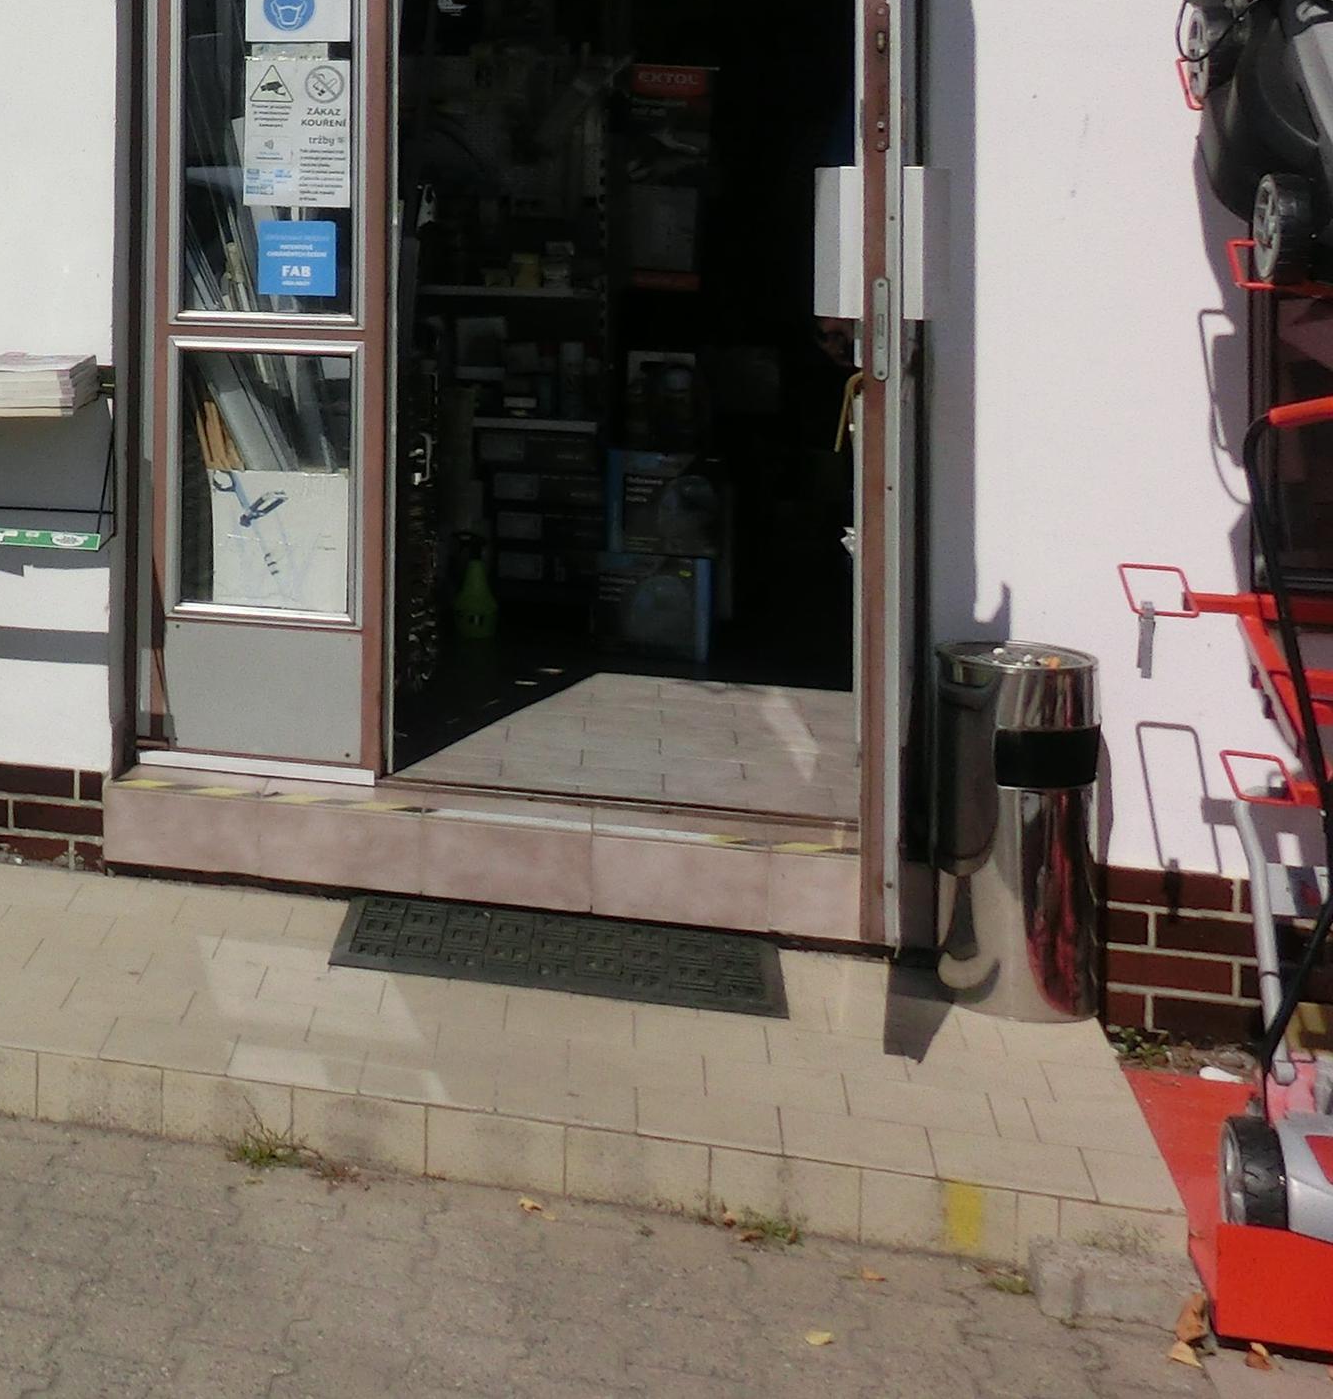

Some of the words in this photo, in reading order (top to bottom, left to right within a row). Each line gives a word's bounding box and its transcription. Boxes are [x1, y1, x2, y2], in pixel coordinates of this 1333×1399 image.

[638, 73, 699, 85] EXTOL
[307, 107, 341, 117] ZÁKAZ
[300, 118, 347, 128] KOUŘENÍ
[281, 265, 312, 278] FAB
